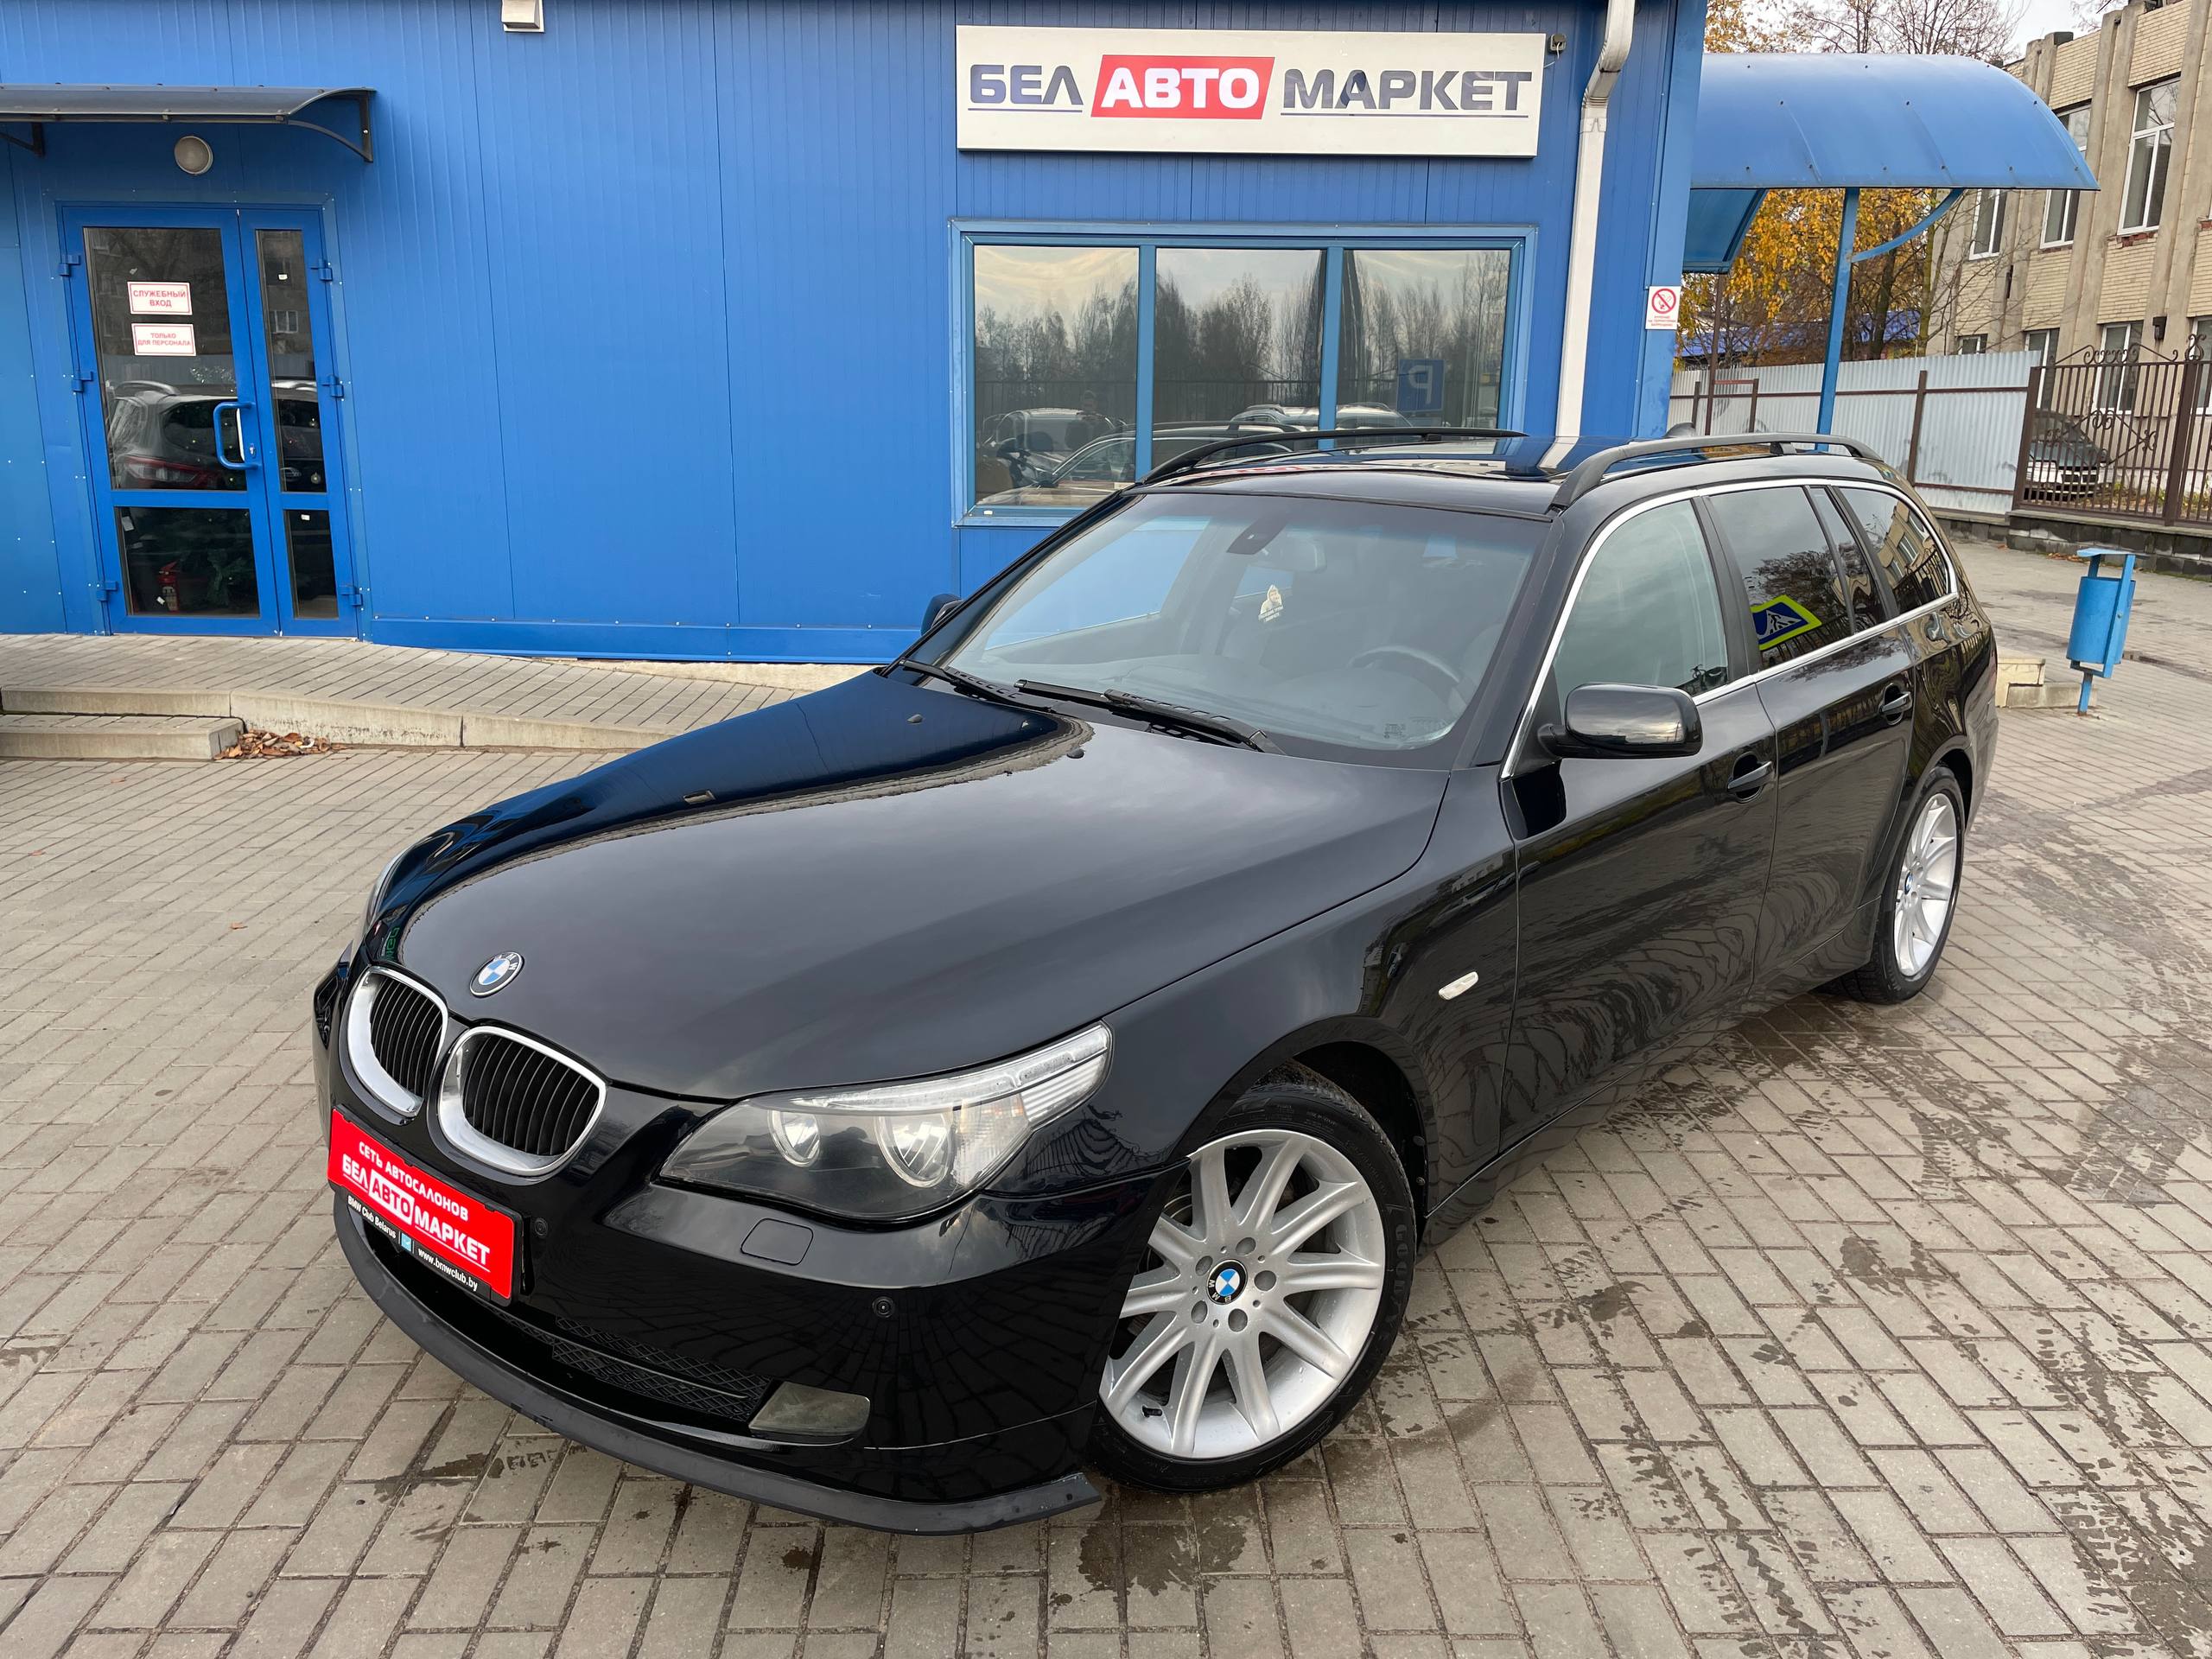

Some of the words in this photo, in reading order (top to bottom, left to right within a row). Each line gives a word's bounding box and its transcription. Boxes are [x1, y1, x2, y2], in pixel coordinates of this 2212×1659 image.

[969, 64, 1084, 106] БЕЛ
[1100, 67, 1262, 110] АВТО
[1283, 68, 1533, 111] МАРКЕТ
[133, 289, 187, 298] СЛУЖЕБНЫЙ
[149, 299, 173, 308] ВХОД
[359, 1141, 384, 1168] СЕТЬ
[385, 1160, 469, 1222] АВТОСАЛОНОВ
[342, 1154, 368, 1189] БЕЛ
[372, 1177, 411, 1217] АВТО
[415, 1205, 491, 1266] МАРКЕТ
[347, 1195, 362, 1212] BMW
[362, 1206, 375, 1223] Club
[375, 1216, 397, 1238] Belarus
[417, 1248, 478, 1292] www.bmwclub.by
